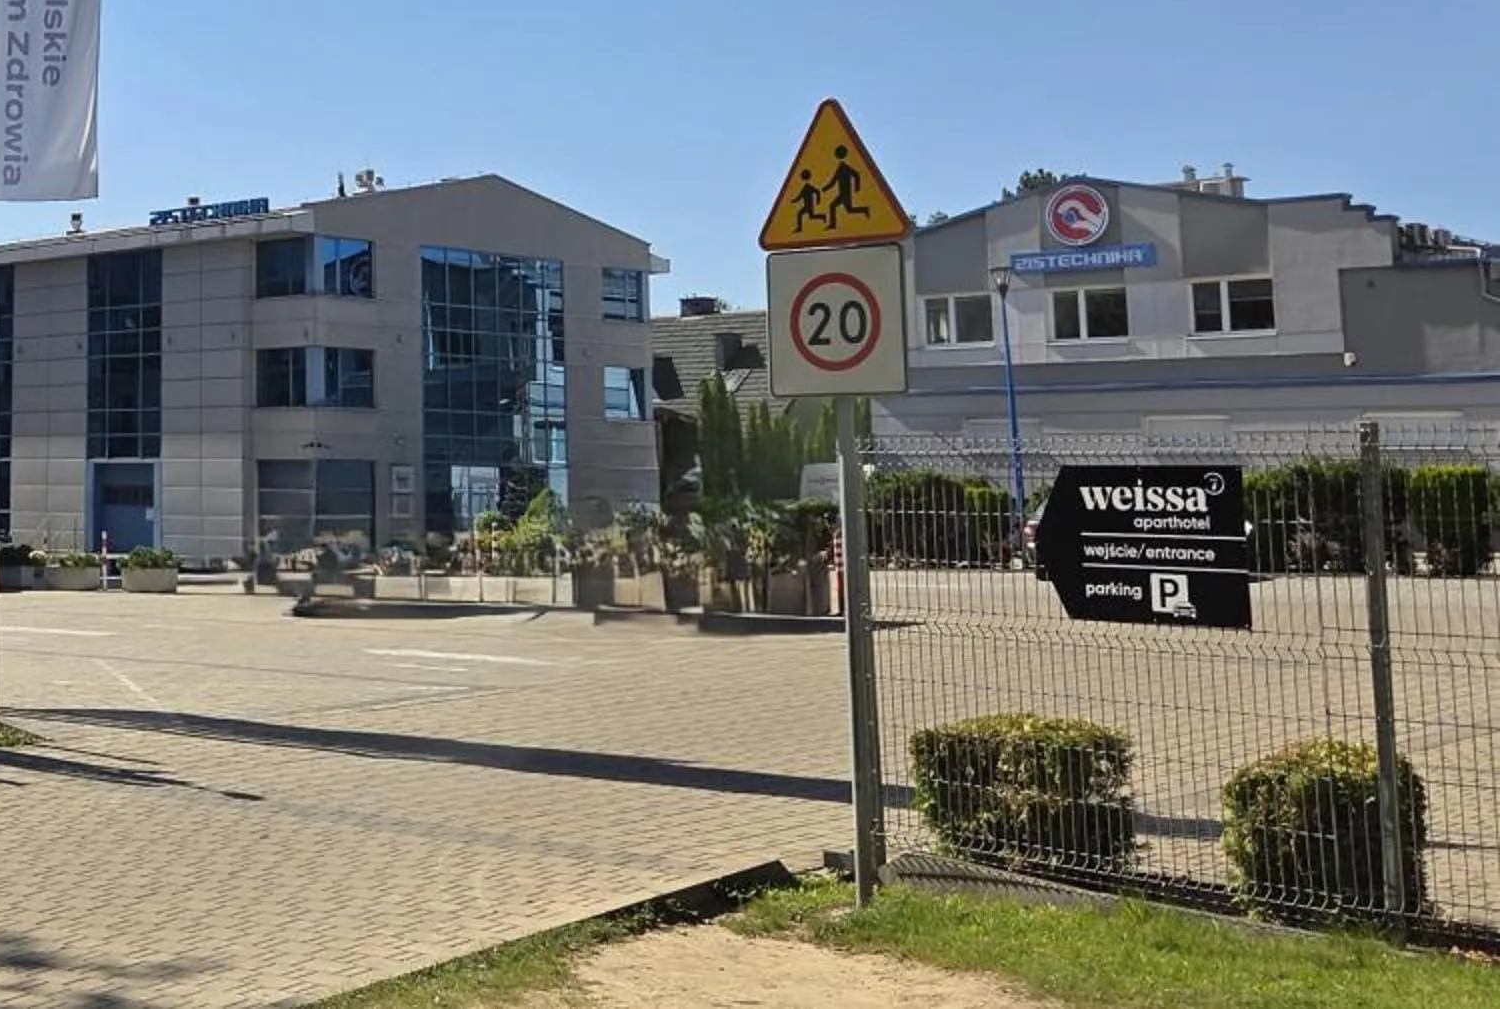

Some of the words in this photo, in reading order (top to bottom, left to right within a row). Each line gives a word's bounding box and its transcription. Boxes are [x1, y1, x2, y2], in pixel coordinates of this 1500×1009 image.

[2, 30, 30, 186] Zdrowia
[807, 299, 868, 347] 20
[1079, 478, 1209, 512] weissa
[1133, 515, 1211, 530] aparthotel
[1085, 582, 1143, 600] parking
[1160, 578, 1180, 608] P
